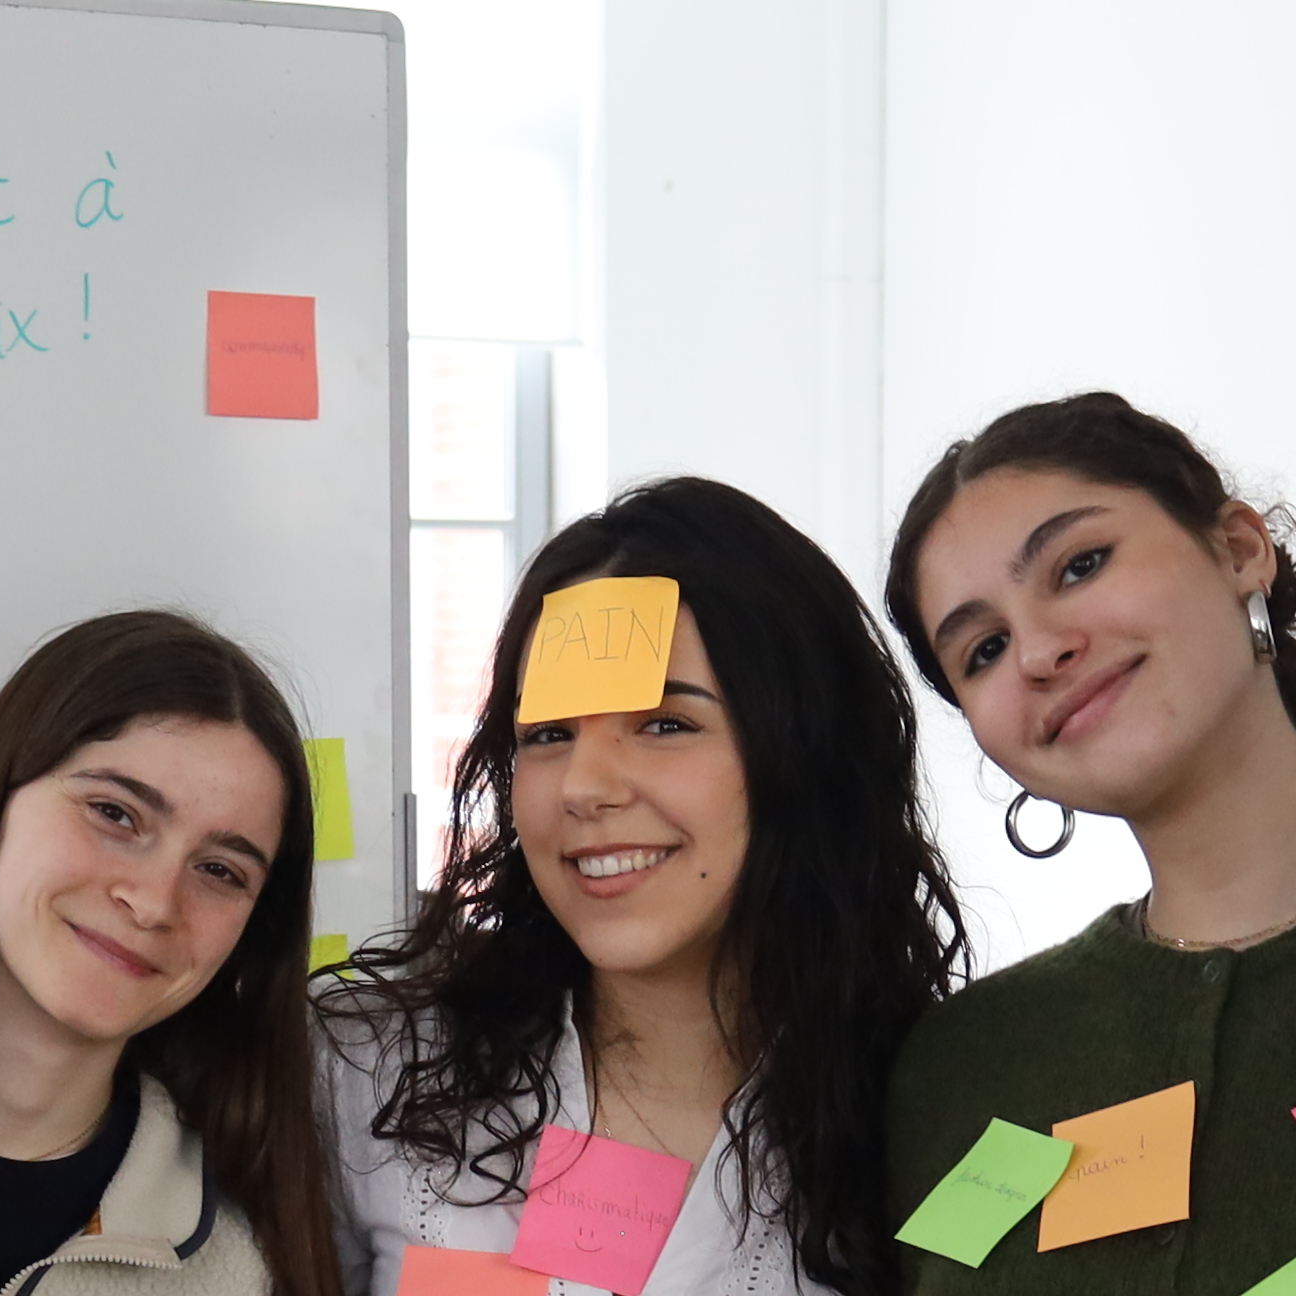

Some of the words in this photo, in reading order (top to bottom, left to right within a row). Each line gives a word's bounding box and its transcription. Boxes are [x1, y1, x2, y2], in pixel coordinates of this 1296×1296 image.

[74, 150, 125, 229] à
[81, 272, 92, 341] !
[538, 605, 664, 665] PAIN
[1138, 1134, 1145, 1160] !
